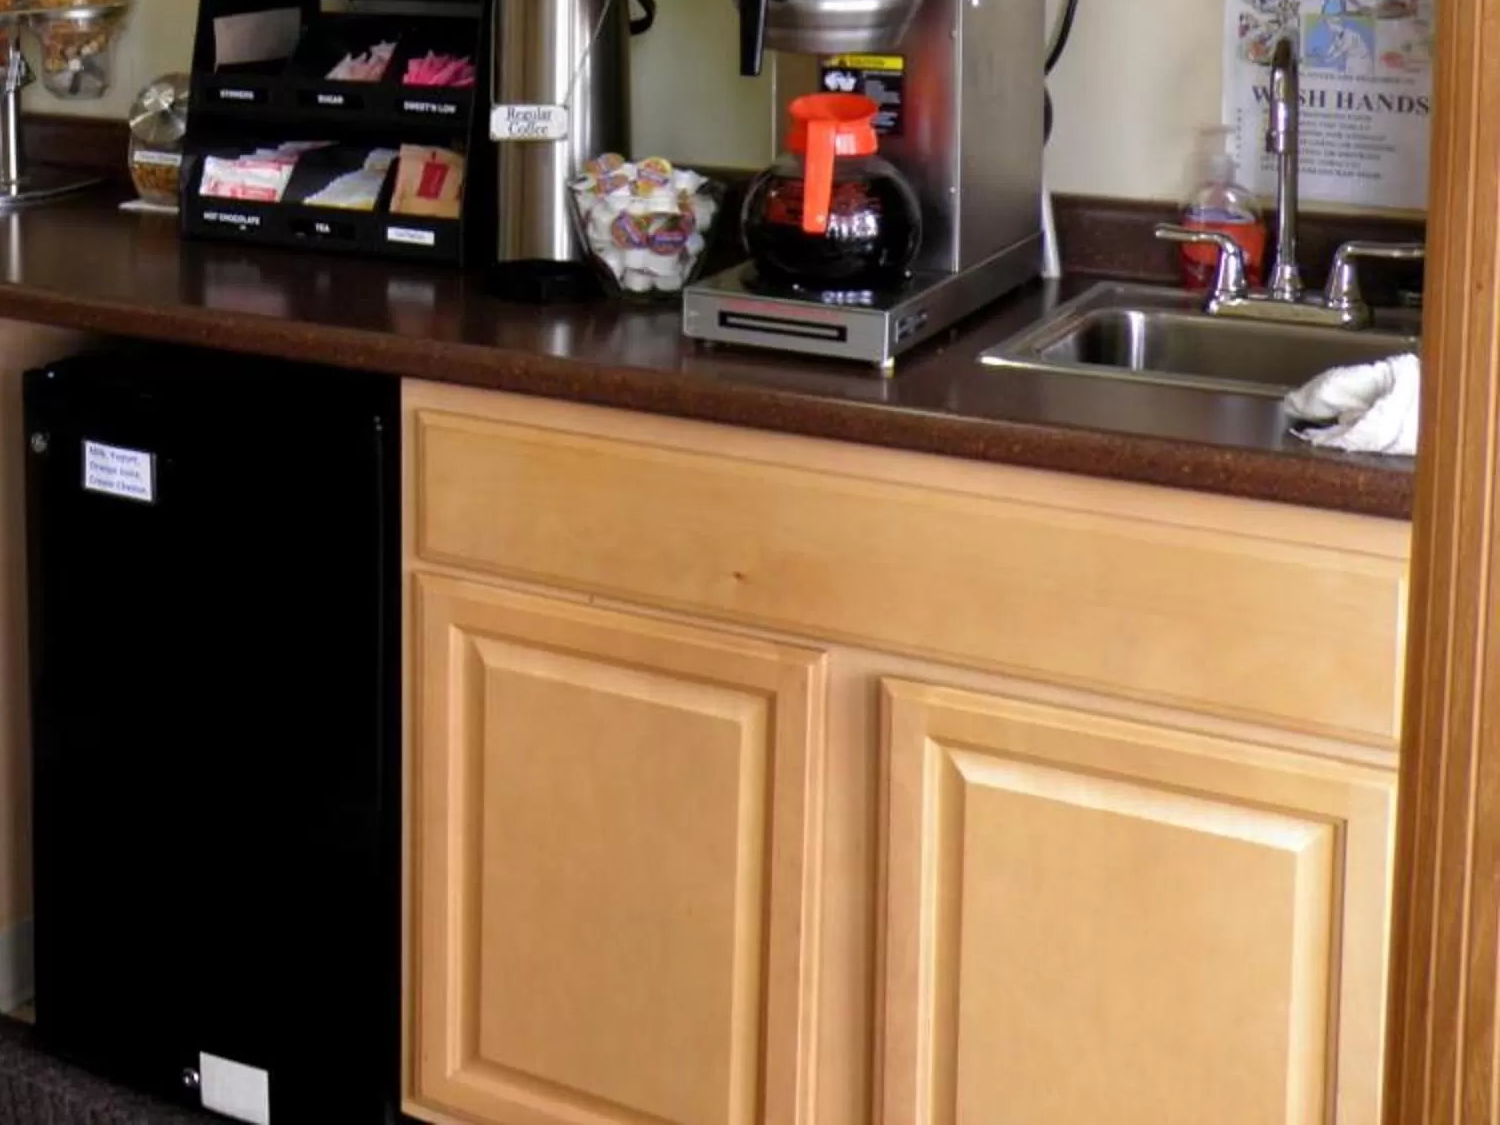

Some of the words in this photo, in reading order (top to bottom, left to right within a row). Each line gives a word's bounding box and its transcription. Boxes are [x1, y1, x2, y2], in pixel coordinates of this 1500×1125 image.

[1252, 85, 1327, 109] WSH
[1336, 90, 1430, 116] HANDS
[506, 106, 552, 122] Regular
[508, 122, 548, 136] Coffee
[219, 213, 261, 226] CHOCOLATE
[315, 222, 331, 233] TEA
